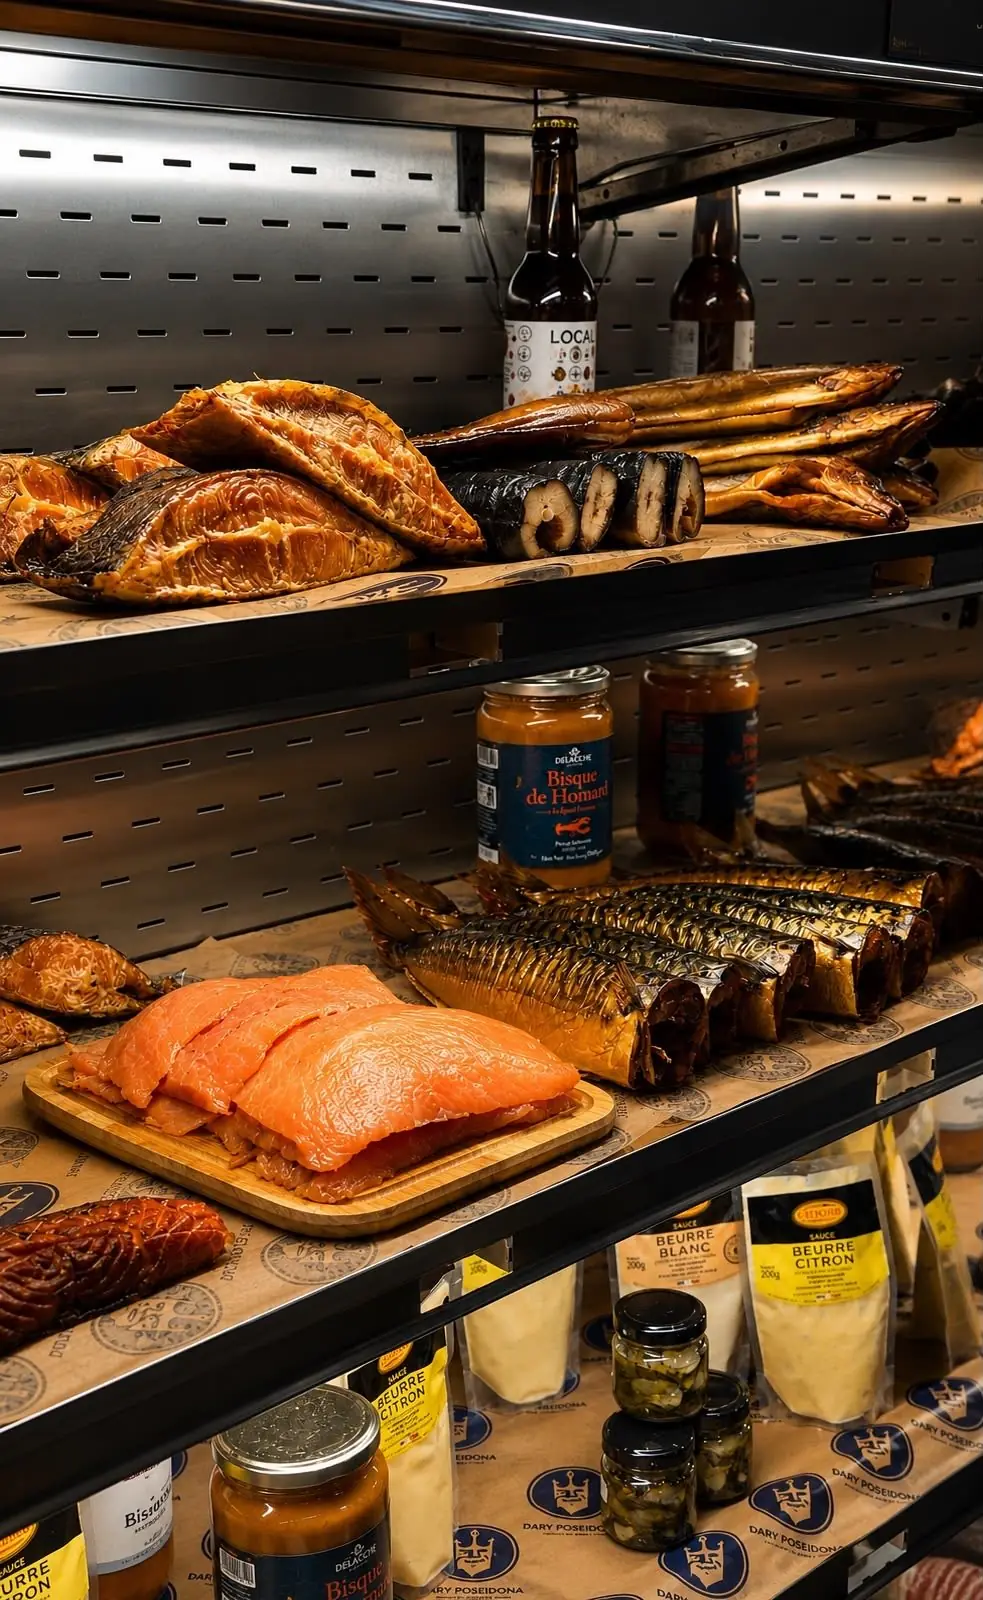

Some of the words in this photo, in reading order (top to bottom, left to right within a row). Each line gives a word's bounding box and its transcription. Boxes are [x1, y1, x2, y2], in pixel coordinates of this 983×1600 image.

[550, 329, 594, 344] LOCAL
[547, 770, 598, 789] Bisque
[526, 787, 547, 805] de
[551, 780, 608, 805] Homard
[672, 1219, 697, 1230] SAUCE
[656, 1228, 715, 1247] BEURRE
[809, 1231, 836, 1241] SAUCE
[659, 1241, 711, 1258] BLANC
[792, 1240, 856, 1257] BEURRE
[627, 1260, 646, 1272] 200g
[795, 1253, 855, 1270] CITRON
[760, 1269, 781, 1281] 200g
[377, 1371, 426, 1410] BEURRE
[380, 1385, 426, 1421] CITRON
[911, 1419, 938, 1437] DARY
[832, 1468, 860, 1485] DARY
[522, 1523, 553, 1532] DARY
[749, 1525, 779, 1543] DARY
[8, 1576, 52, 1600] RON
[326, 1561, 383, 1600] Bisque
